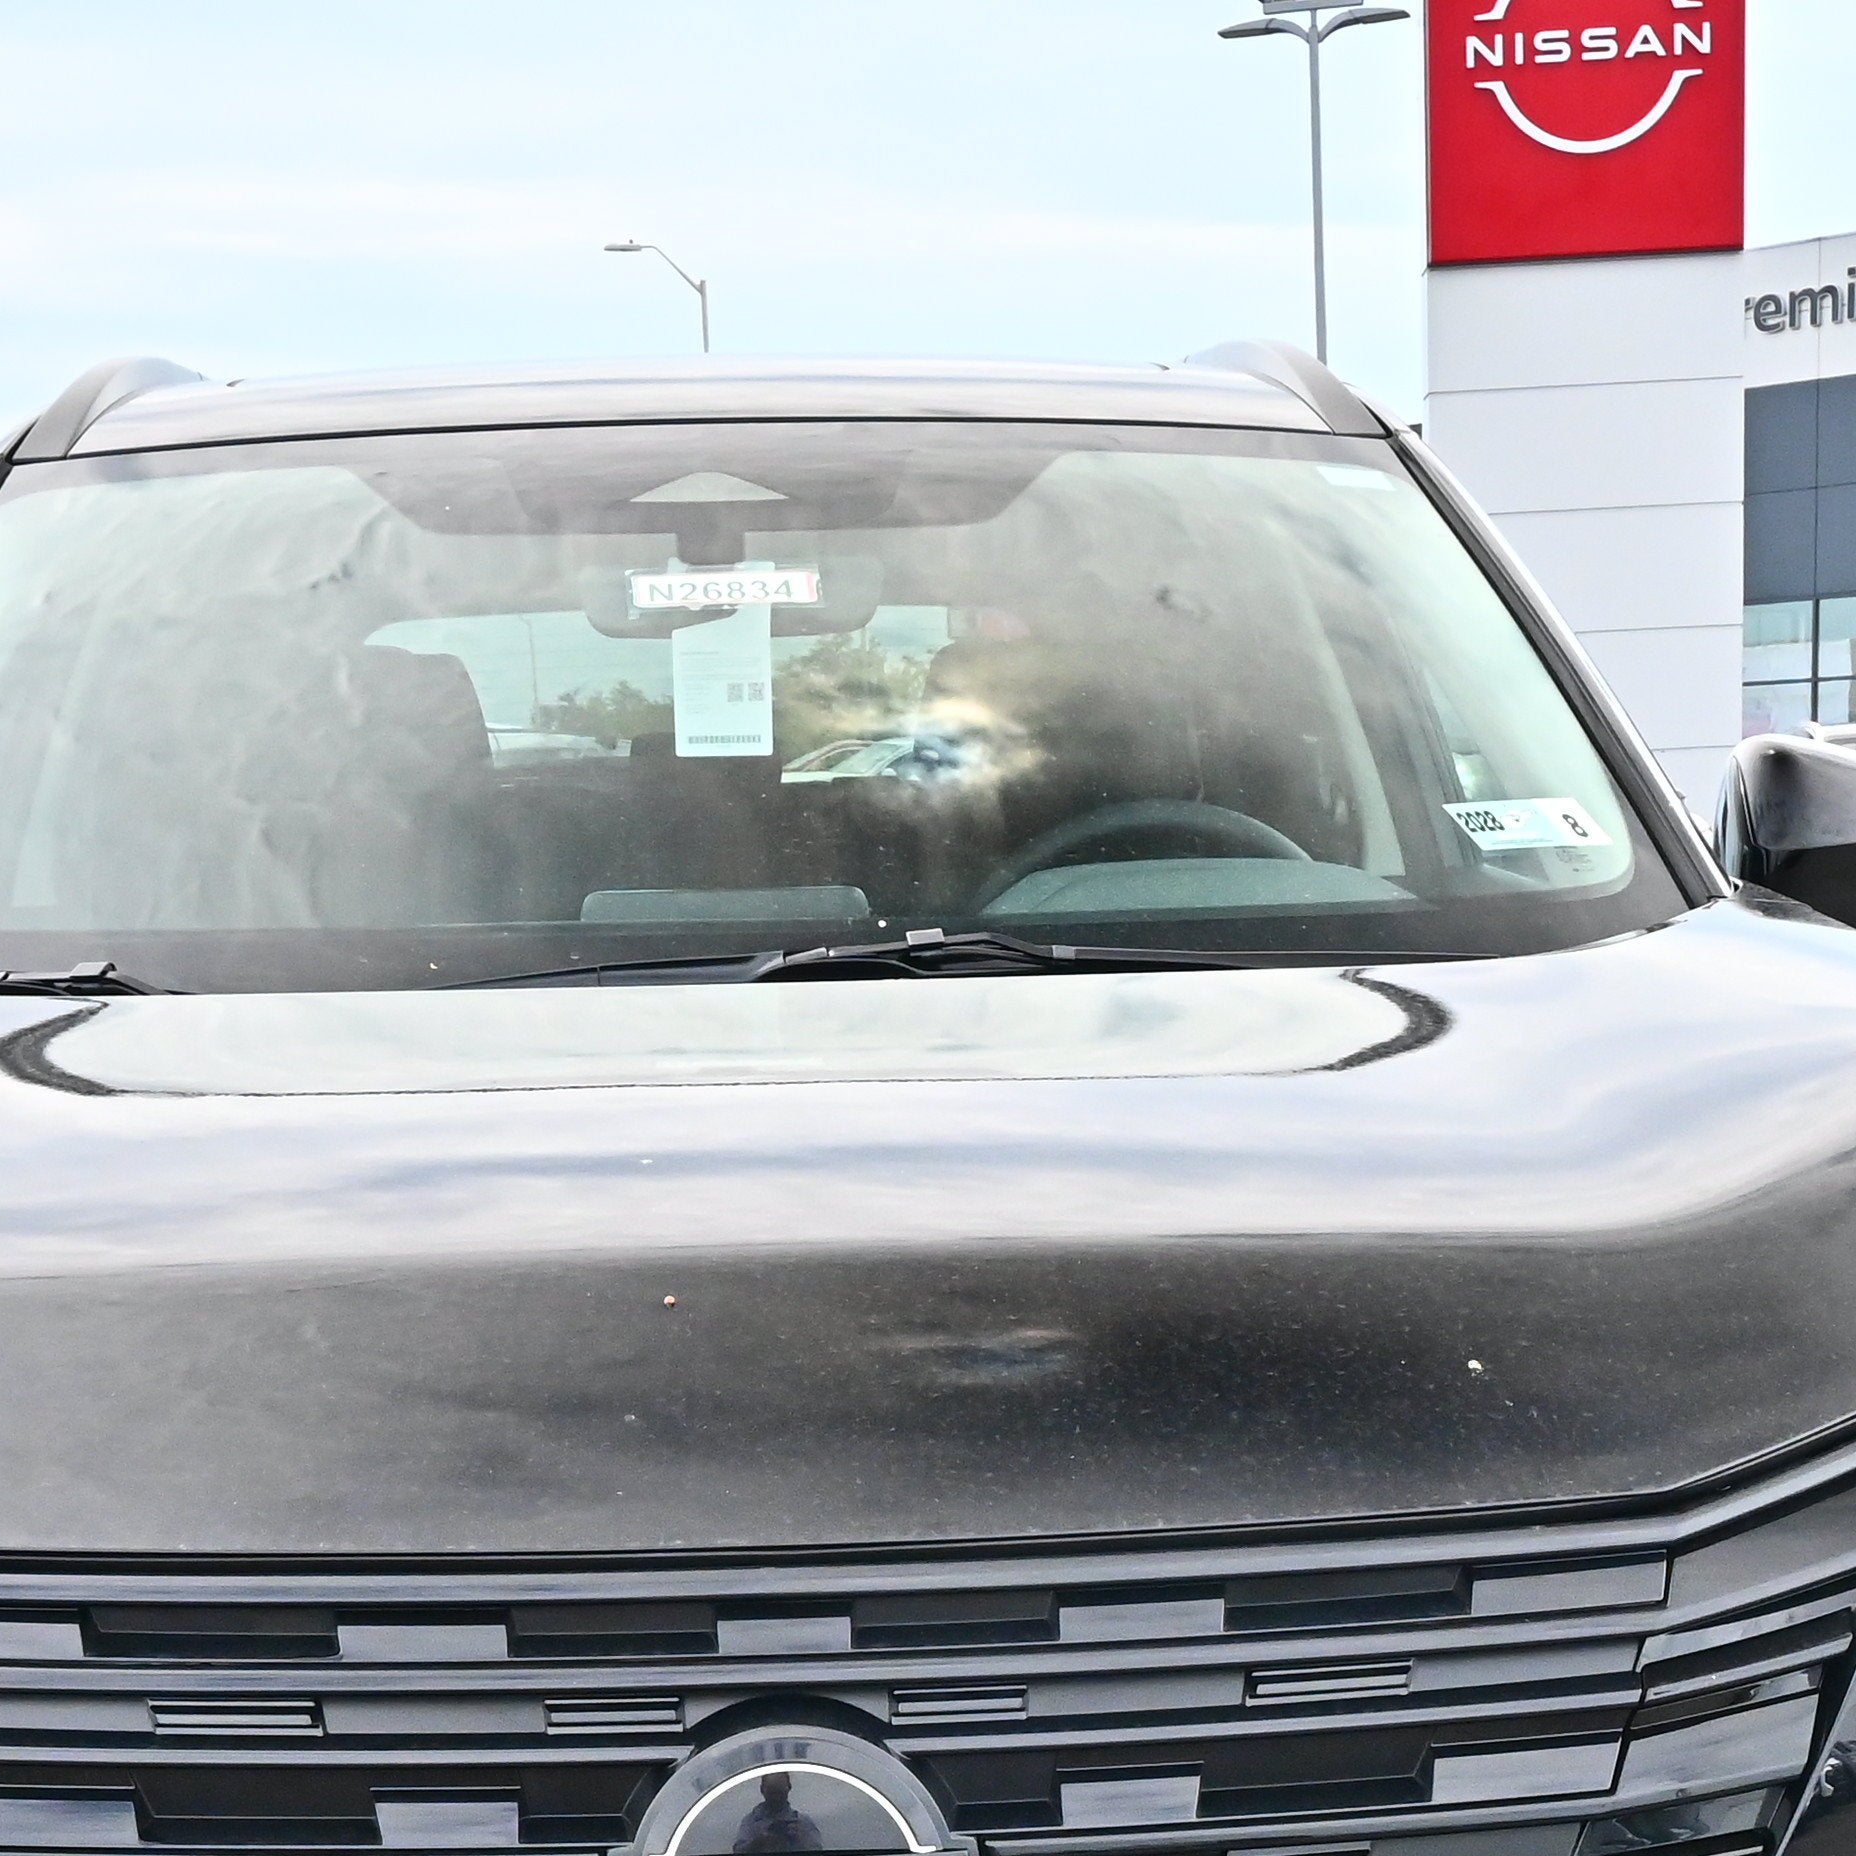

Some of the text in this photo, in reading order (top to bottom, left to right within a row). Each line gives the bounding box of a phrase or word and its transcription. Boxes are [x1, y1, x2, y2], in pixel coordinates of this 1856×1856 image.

[1464, 20, 1712, 69] NISSAN
[648, 579, 795, 602] N26834
[1456, 809, 1589, 838] 2028 8
